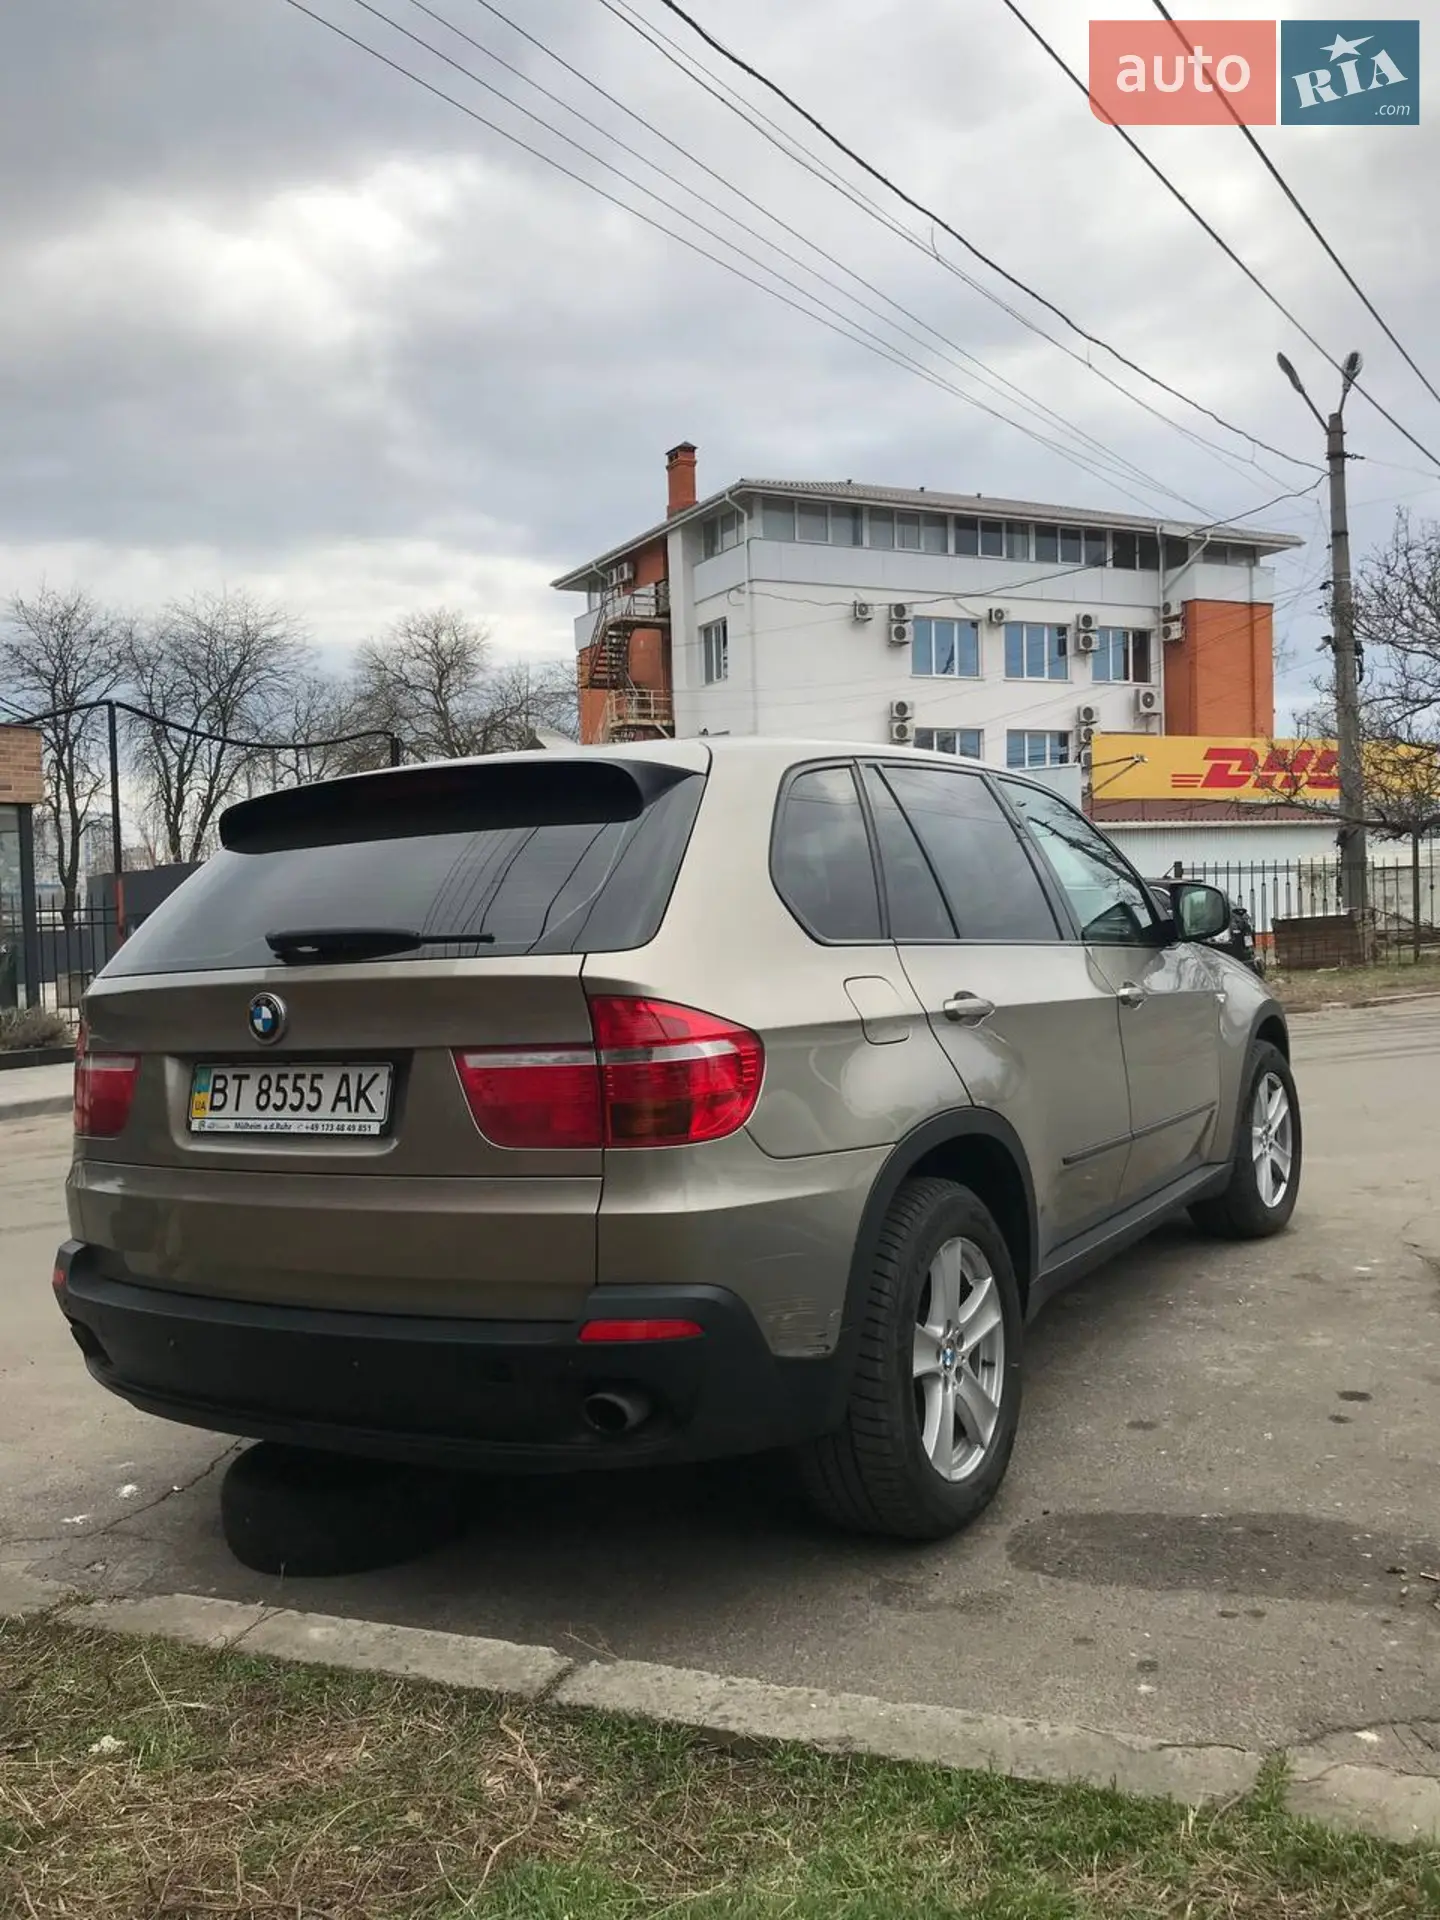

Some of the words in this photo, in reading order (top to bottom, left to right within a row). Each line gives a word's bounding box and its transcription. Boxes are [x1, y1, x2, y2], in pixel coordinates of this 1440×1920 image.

[209, 1073, 251, 1112] BT
[256, 1073, 324, 1112] 8555
[330, 1072, 380, 1113] AK
[195, 1102, 207, 1111] UA
